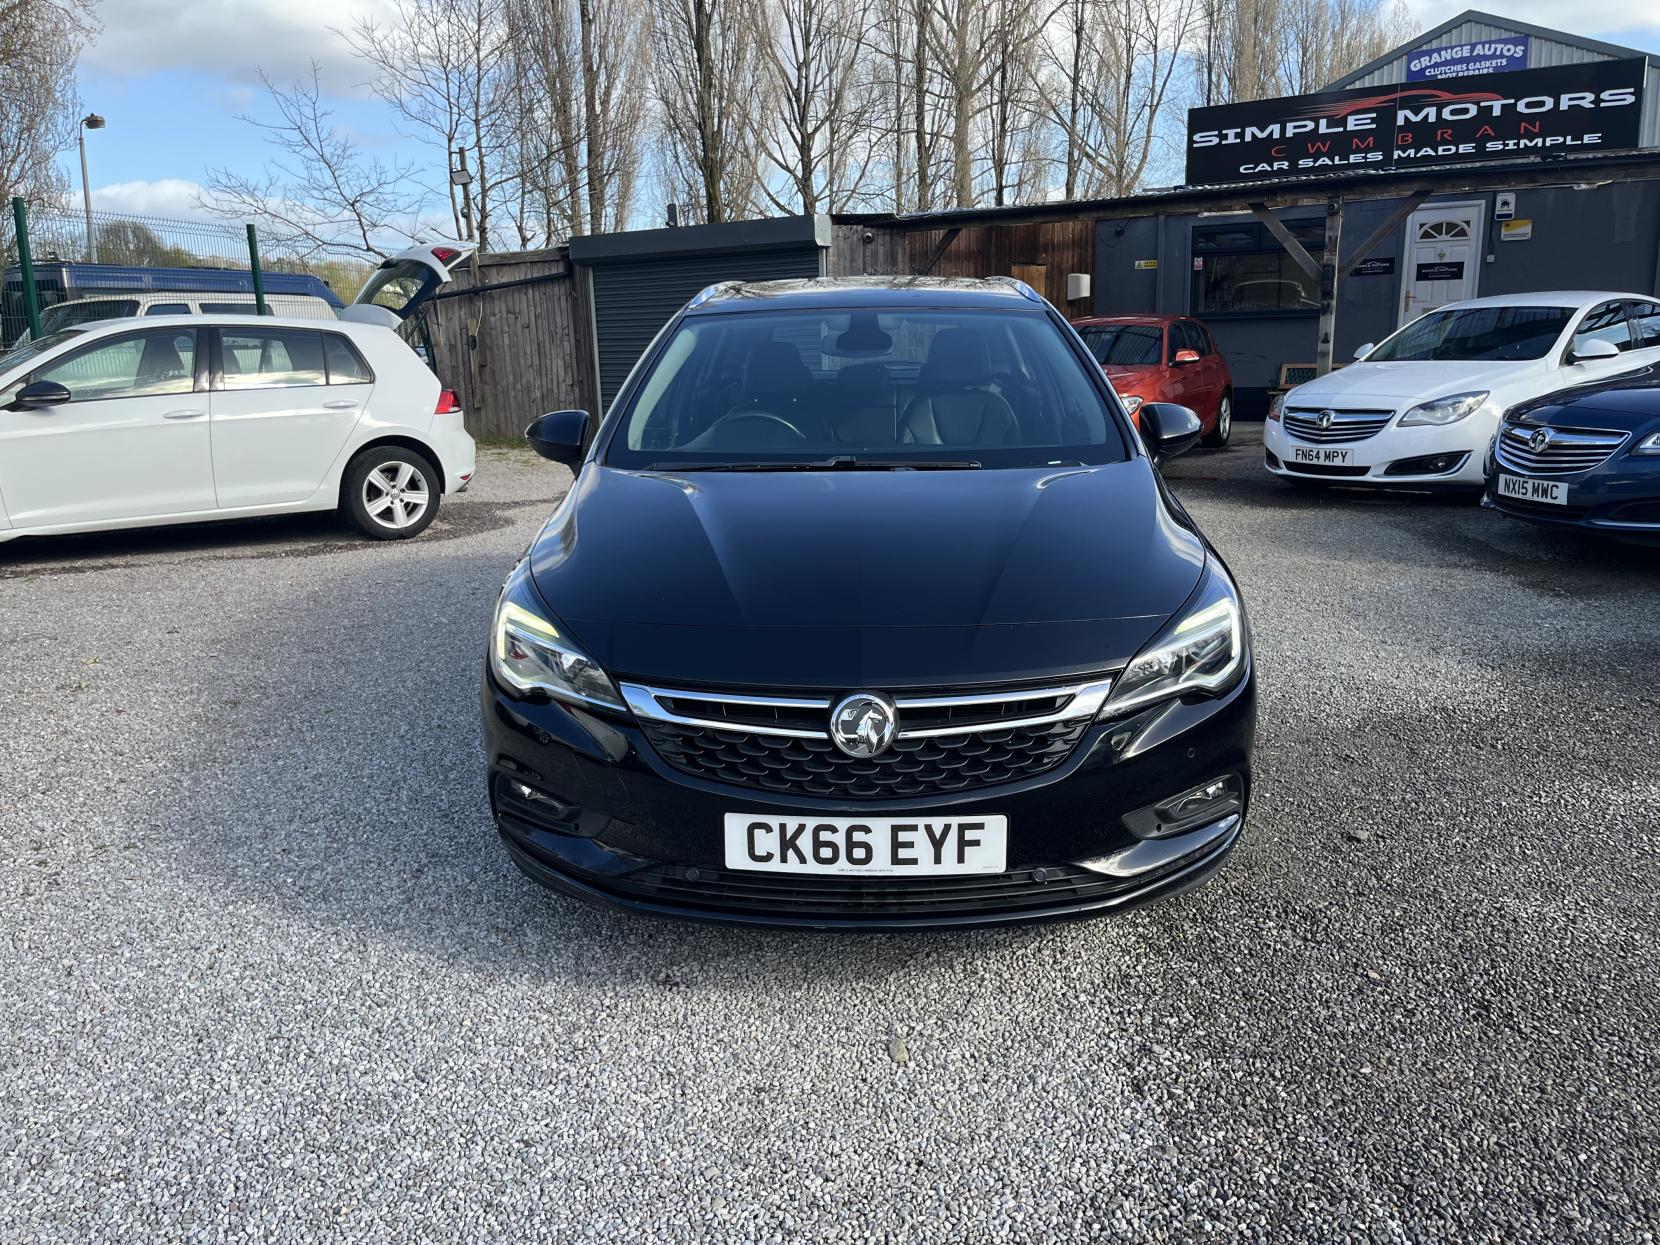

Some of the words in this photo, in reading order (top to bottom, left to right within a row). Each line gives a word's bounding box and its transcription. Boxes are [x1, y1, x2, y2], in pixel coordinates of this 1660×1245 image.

[1409, 46, 1471, 72] GRANGE
[1473, 43, 1525, 58] AUTOS
[1425, 64, 1467, 76] CLUTCHES
[1468, 58, 1507, 69] GASKETS
[1192, 112, 1377, 148] SIMPLE
[1397, 87, 1636, 126] MOTORS
[1239, 161, 1290, 174] CAR
[1298, 151, 1384, 168] SALES
[1393, 143, 1476, 160] MADE
[1485, 133, 1602, 152] SIMPLE
[1271, 121, 1540, 157] CWMBRAN
[1295, 448, 1321, 463] FN64
[1323, 450, 1349, 464] MPY
[1503, 477, 1529, 497] NX15
[1531, 481, 1560, 500] MWC
[746, 821, 874, 866] CK66
[890, 822, 986, 866] EYF
